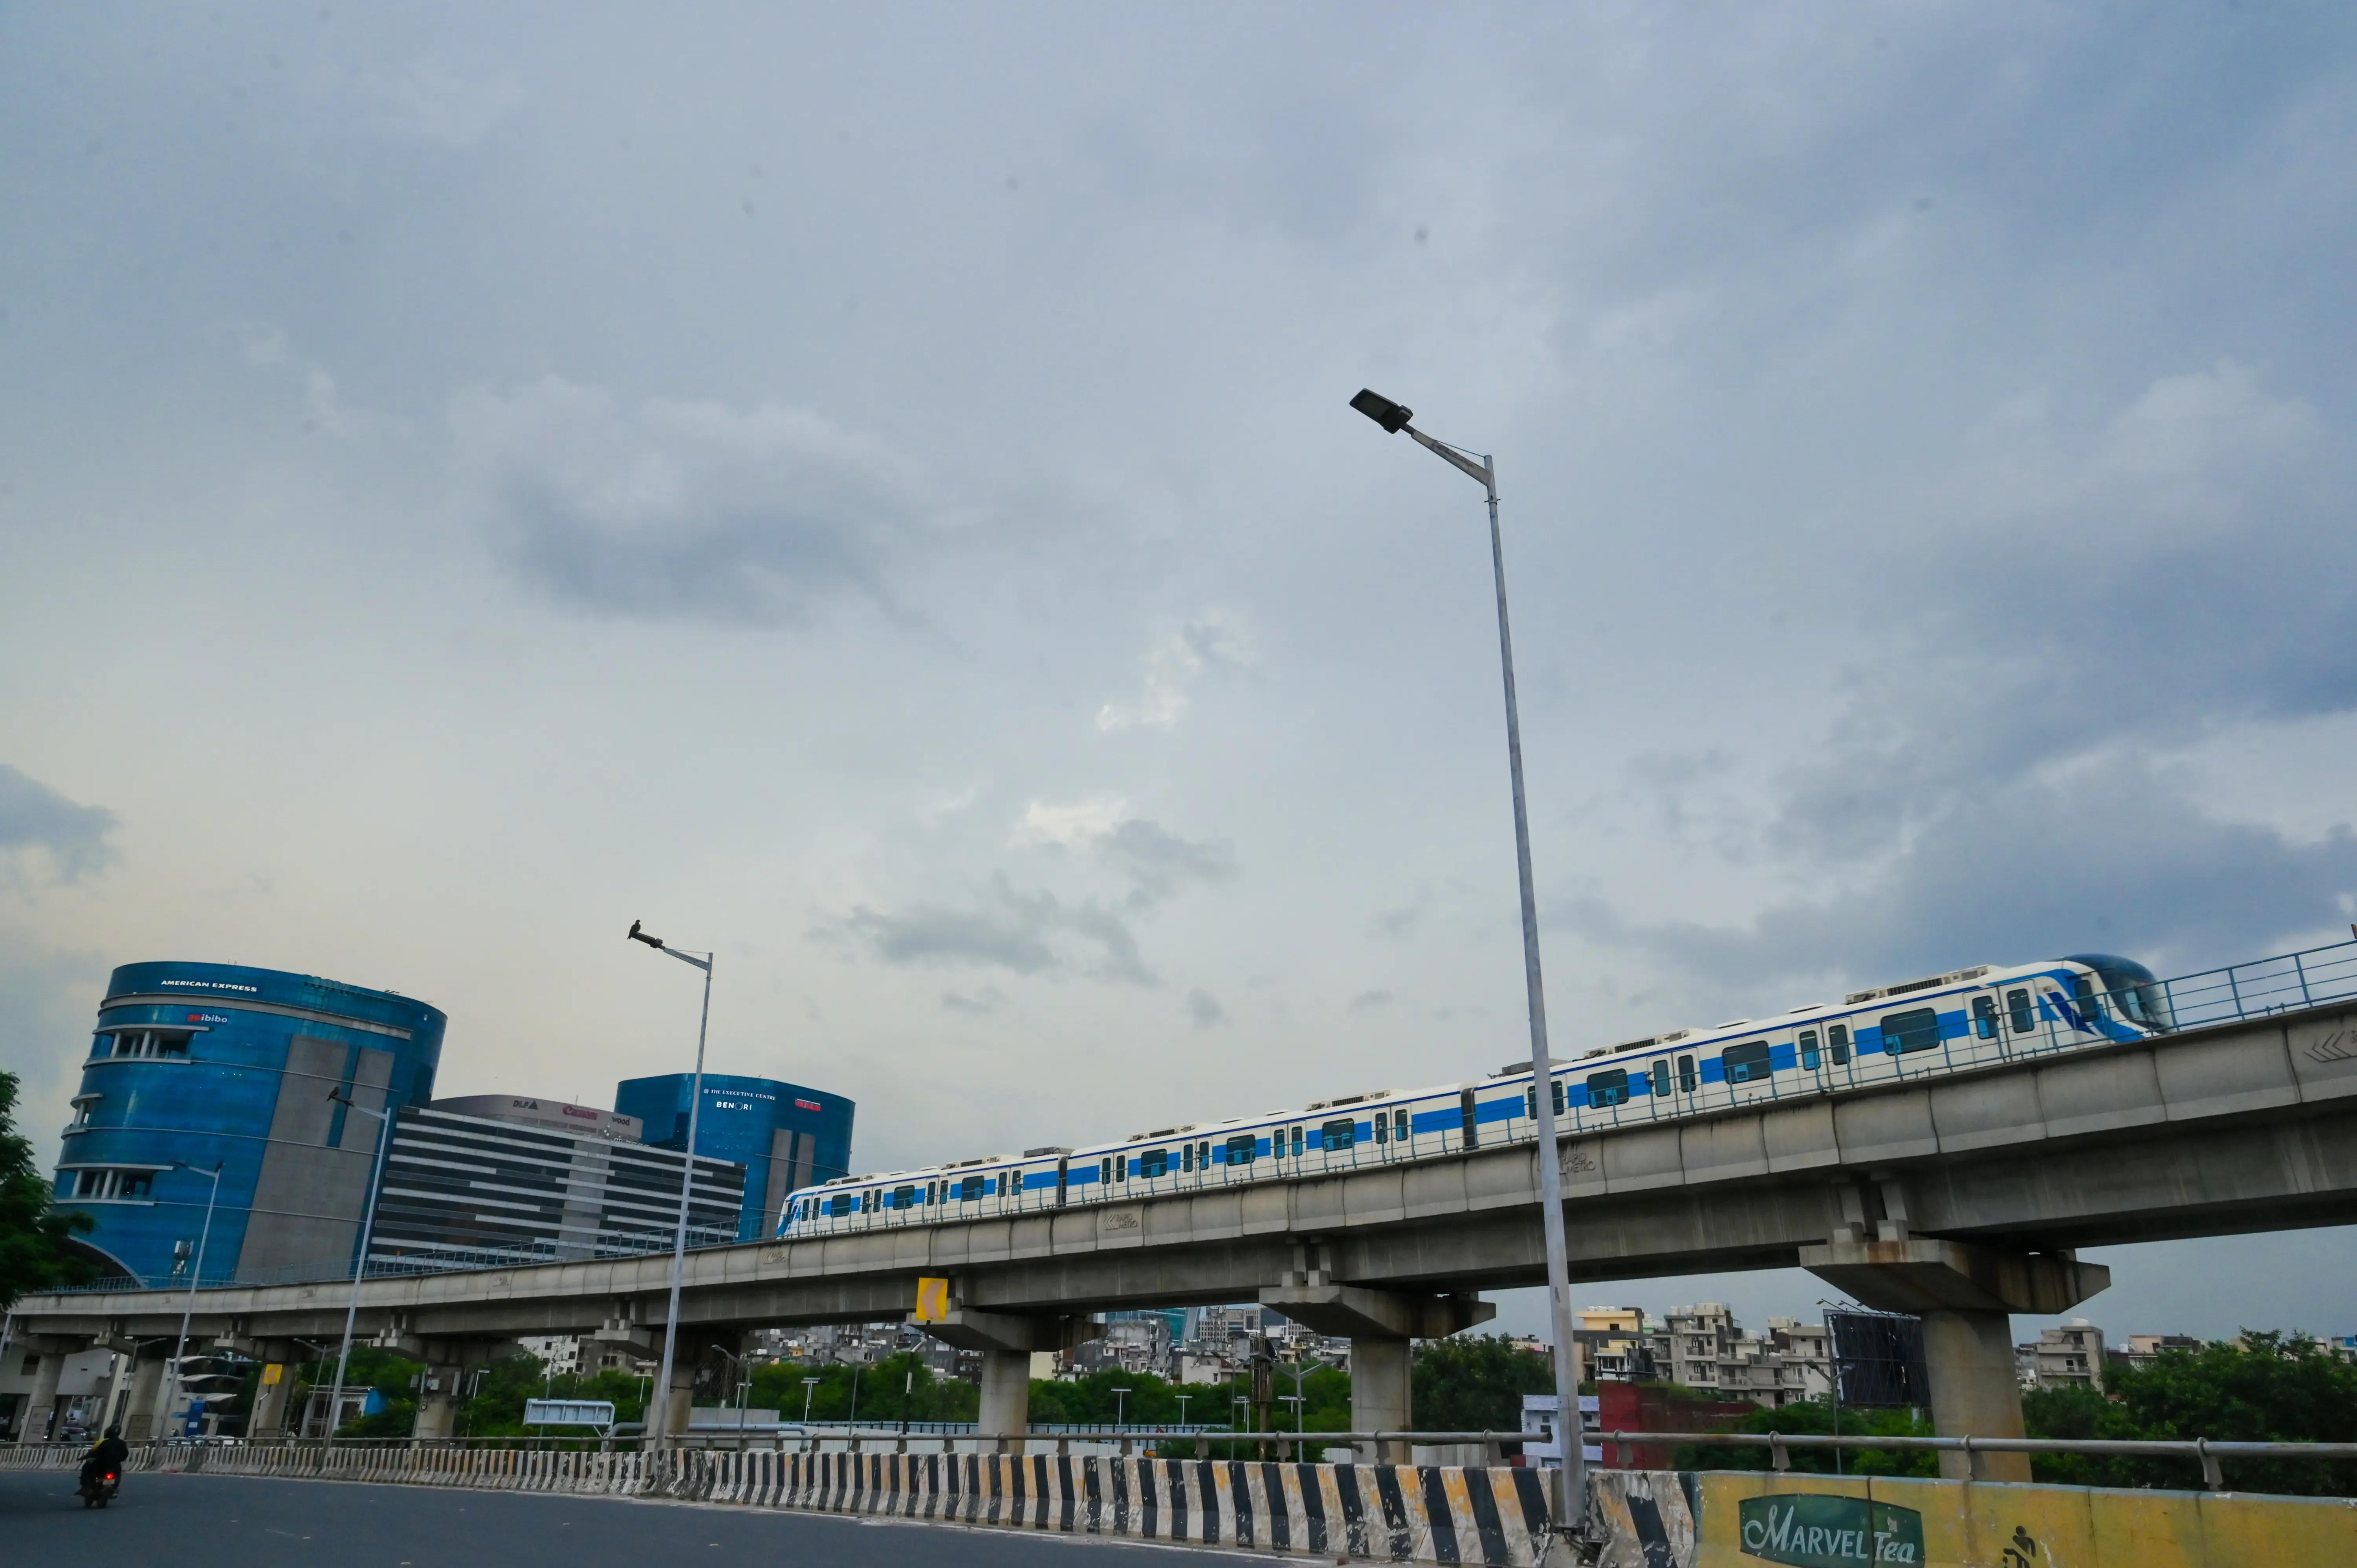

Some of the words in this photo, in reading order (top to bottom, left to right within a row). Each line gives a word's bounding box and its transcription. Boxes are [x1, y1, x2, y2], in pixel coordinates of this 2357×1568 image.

[212, 983, 257, 992] EXPRESS
[512, 1100, 529, 1108] DLF
[716, 1101, 752, 1110] BENORI
[1873, 1531, 1915, 1564] Tea
